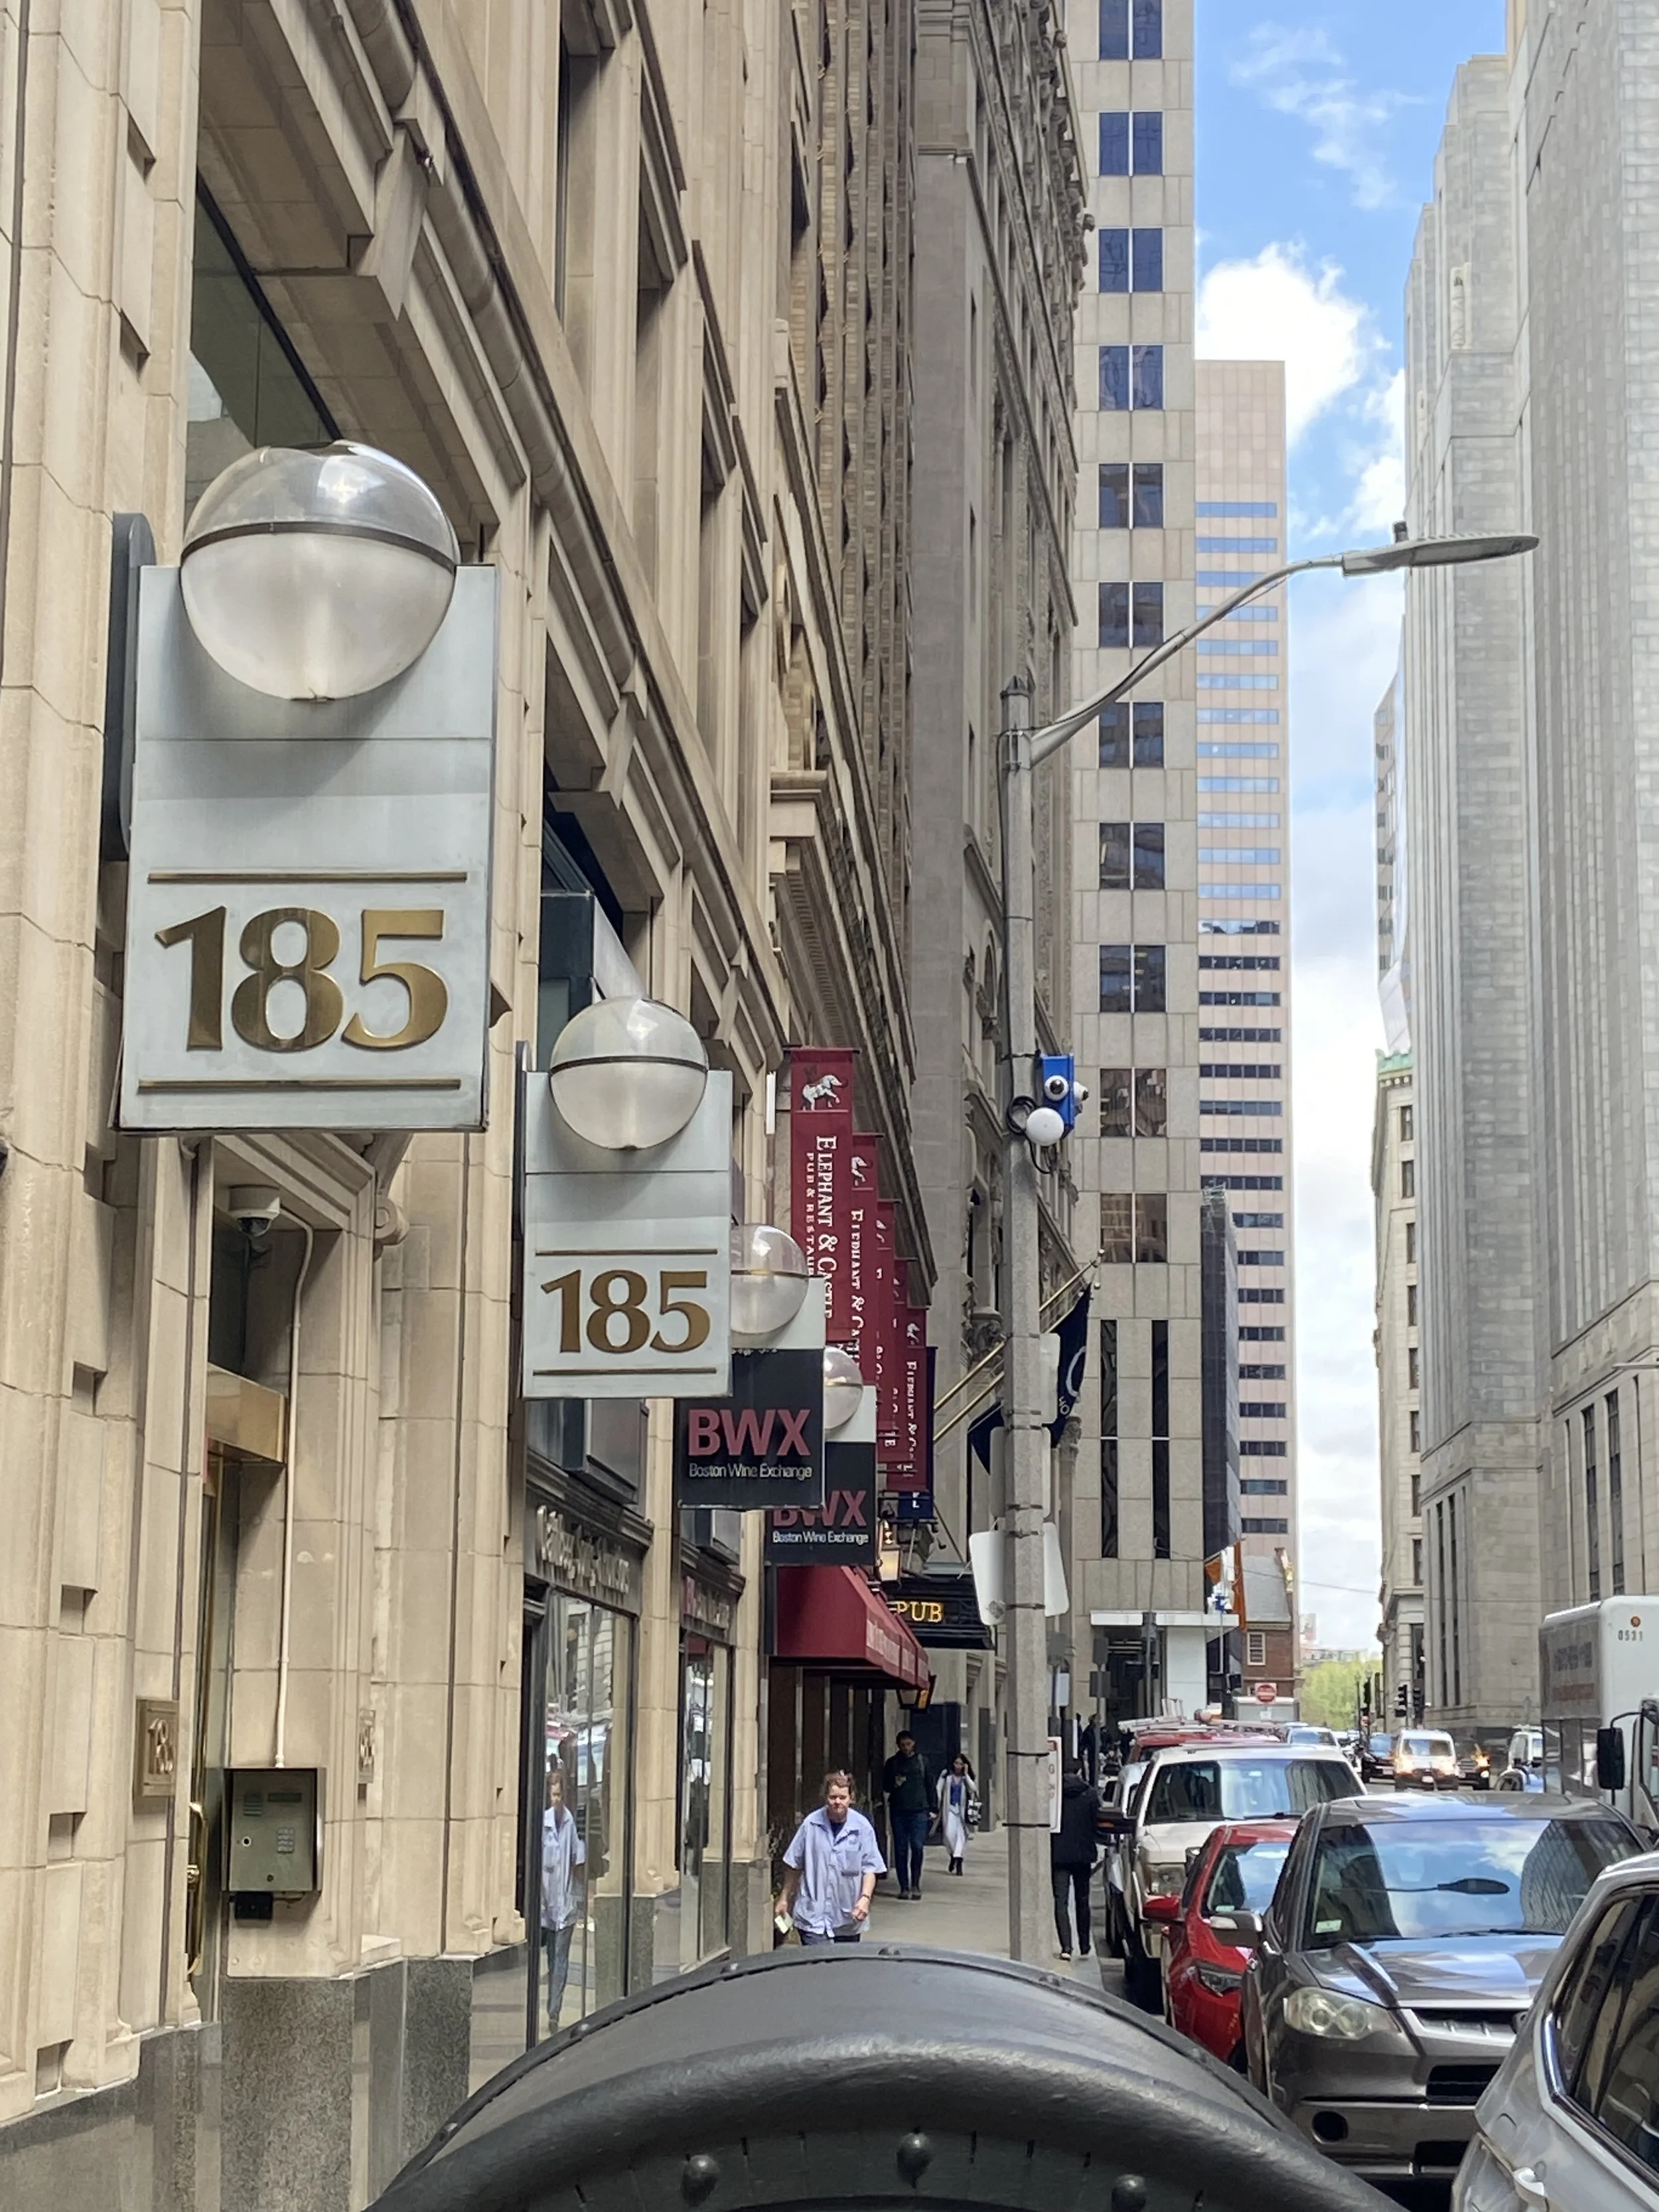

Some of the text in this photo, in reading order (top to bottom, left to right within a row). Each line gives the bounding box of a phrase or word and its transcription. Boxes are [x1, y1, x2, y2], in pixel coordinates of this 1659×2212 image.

[155, 905, 449, 1053] 185
[806, 1151, 815, 1184] PUB
[816, 1136, 837, 1227] ELEPHANT
[806, 1187, 816, 1199] &
[818, 1233, 837, 1253] &
[540, 1269, 711, 1354] 185
[687, 1408, 811, 1457] BWX
[689, 1462, 812, 1481] Boston Wine Exchange
[772, 1530, 869, 1546] Boston Wine Exchange
[896, 1600, 943, 1623] PUB
